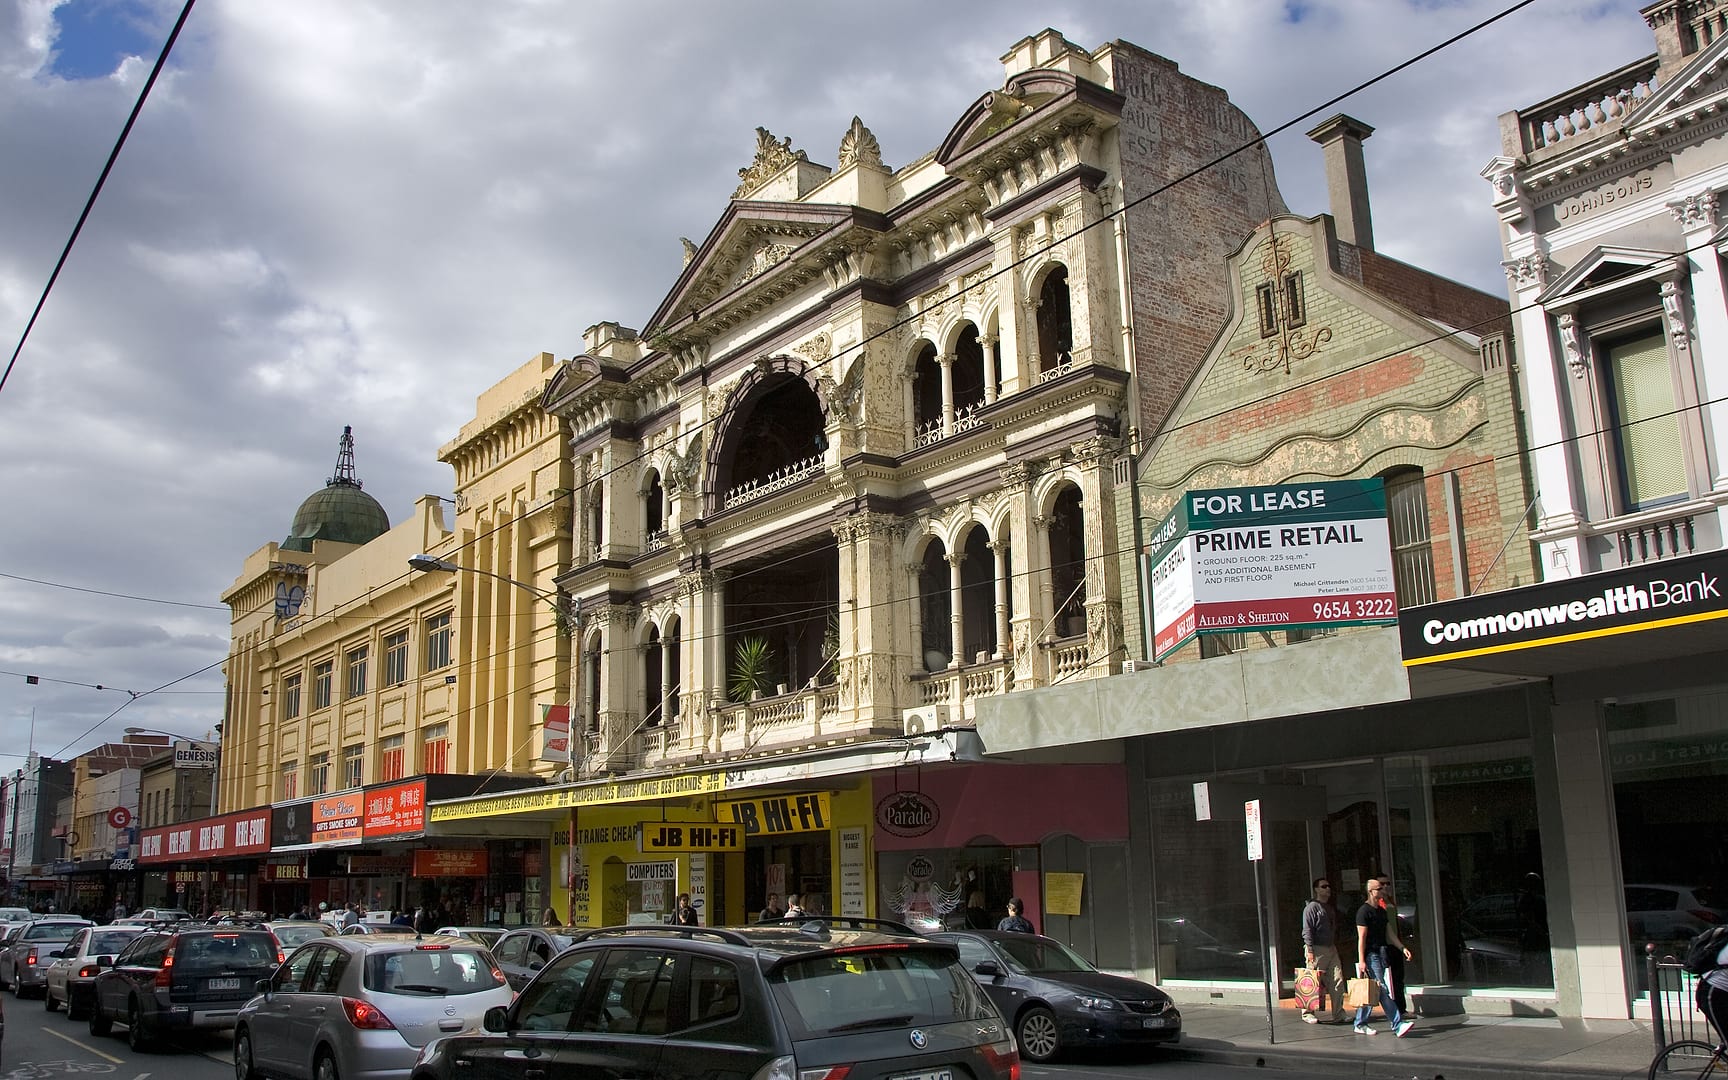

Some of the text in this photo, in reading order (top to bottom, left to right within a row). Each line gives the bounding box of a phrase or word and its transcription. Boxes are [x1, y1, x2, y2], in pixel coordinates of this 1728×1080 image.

[1561, 176, 1653, 219] JOHNSON'S
[1193, 489, 1326, 516] FOR LEASE
[1195, 524, 1364, 553] PRIME RETAIL
[1203, 556, 1238, 566] GROUND
[1240, 555, 1268, 564] FLOOR:
[1270, 554, 1284, 562] 225
[1204, 562, 1317, 576] PLUS ADDITIONAL BASEMENT
[1204, 574, 1273, 585] AND FIRST FLOOR
[1317, 578, 1349, 586] Crittenden
[1198, 598, 1394, 627] ALLARD & SHELTON 9654 3222
[176, 750, 215, 761] GENESIS
[707, 771, 720, 782] JB
[617, 783, 638, 799] BIGGEST
[640, 781, 659, 797] RANGE
[661, 779, 676, 795] BEST
[676, 776, 702, 793] BRANDS
[114, 812, 125, 824] G
[731, 794, 824, 834] JB HI-FI
[887, 806, 931, 825] Parade
[235, 817, 266, 847] REBEL SPORT
[316, 822, 329, 832] GIFTS
[329, 819, 345, 830] SMOKE
[345, 817, 358, 828] SHOP
[211, 824, 225, 850] SPORT
[554, 828, 584, 846] BIGGT
[584, 826, 609, 844] RANGE
[652, 827, 737, 847] JB HI-FI
[175, 871, 195, 881] REBEL
[276, 865, 300, 879] REBEL
[629, 862, 674, 880] COMPUTERS
[911, 864, 932, 876] Parade
[697, 886, 704, 894] LG
[976, 1025, 998, 1035] X3
